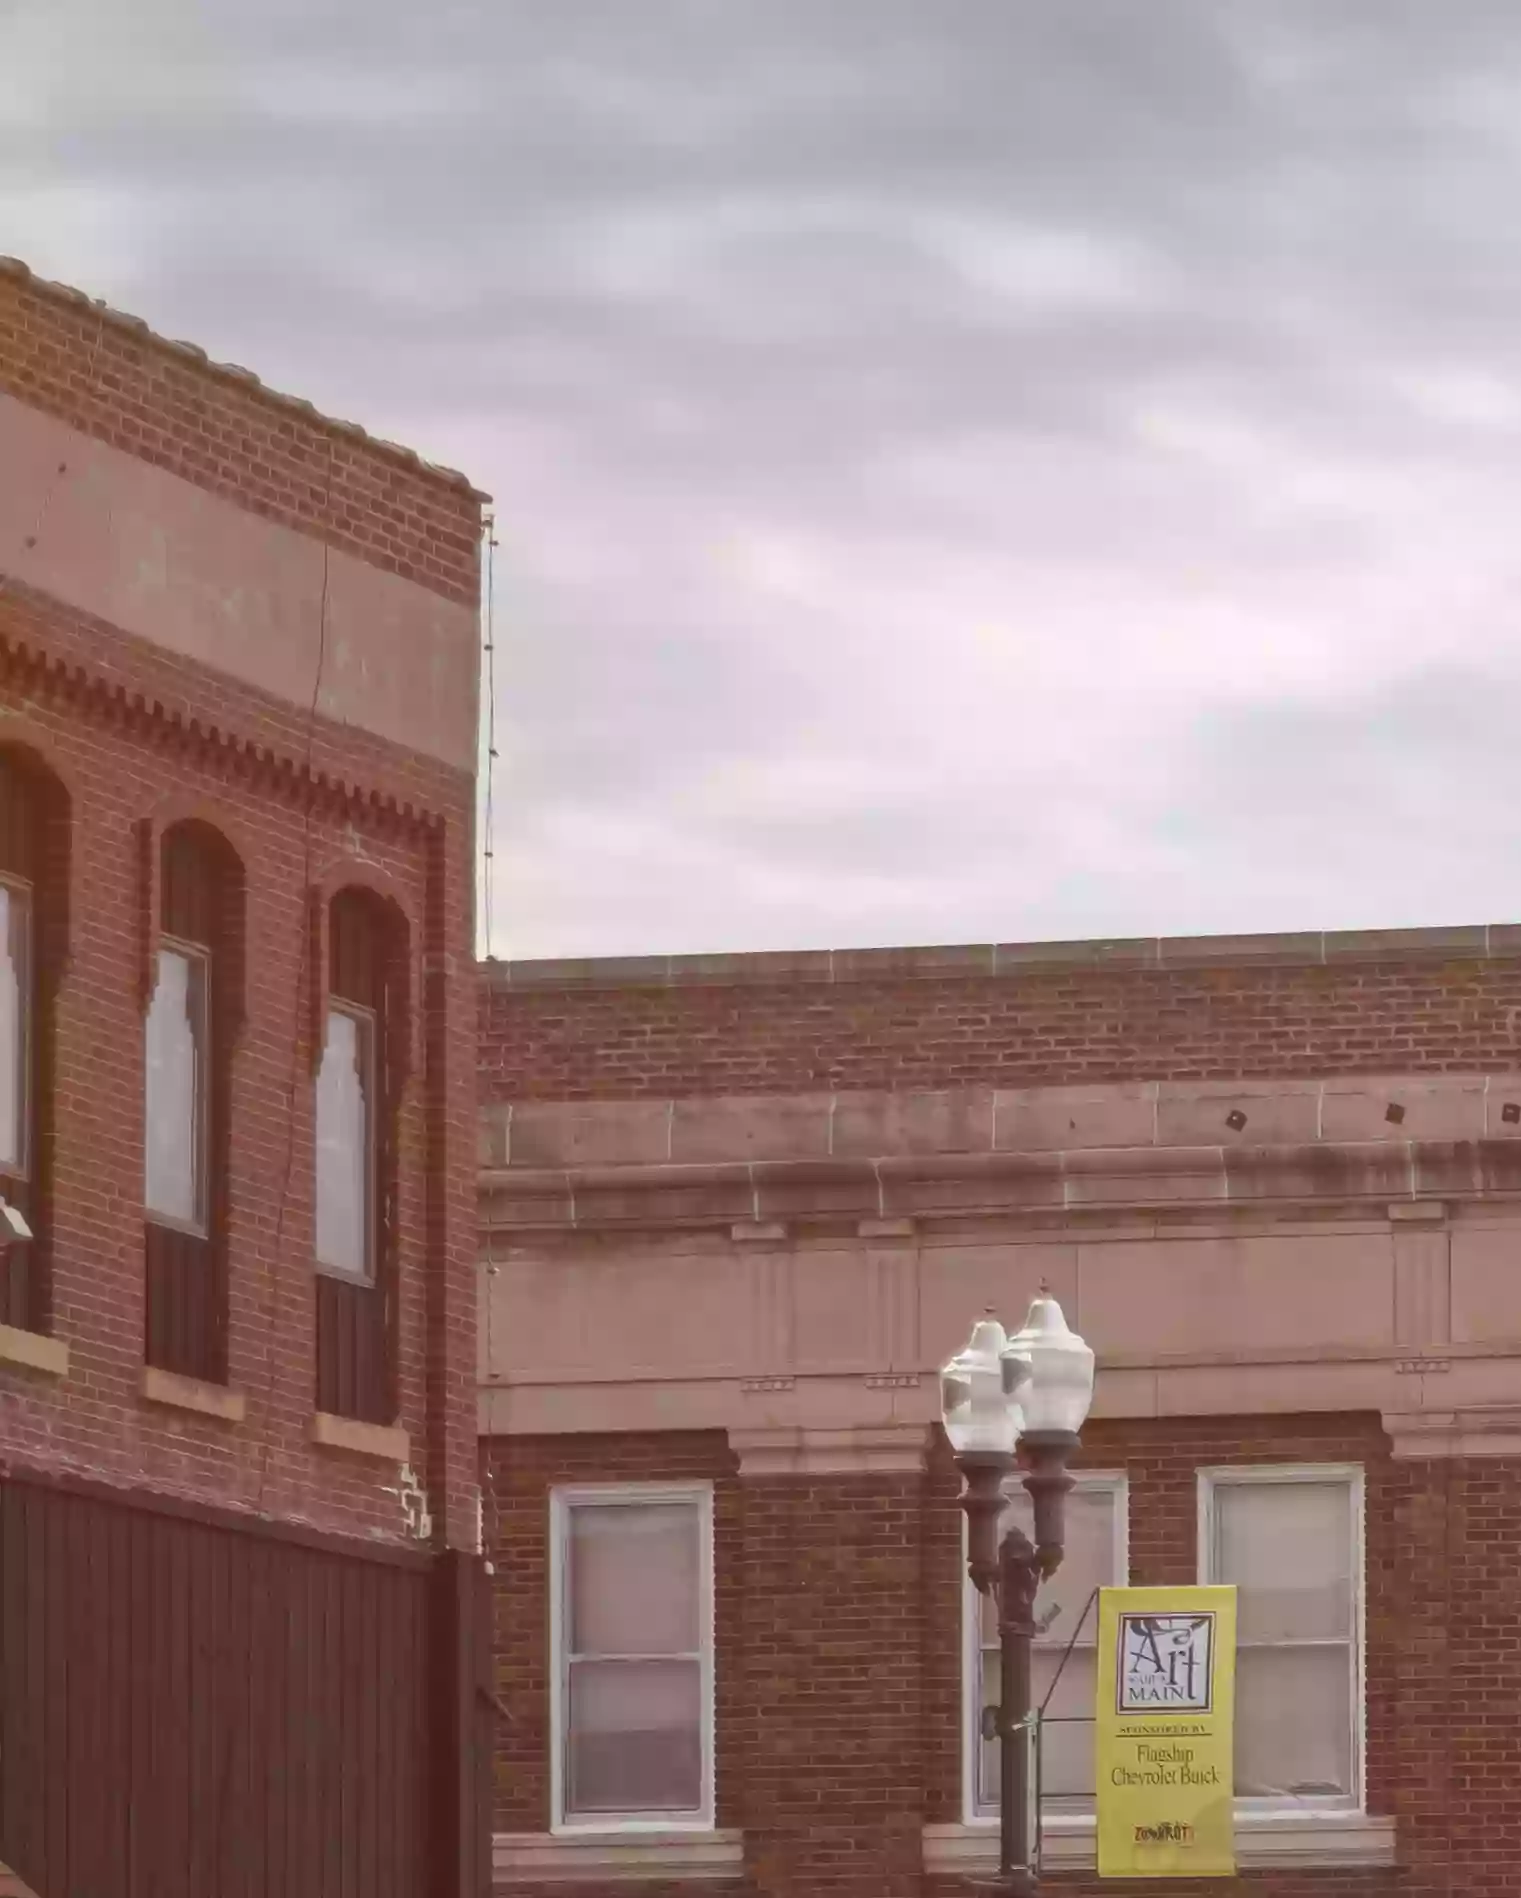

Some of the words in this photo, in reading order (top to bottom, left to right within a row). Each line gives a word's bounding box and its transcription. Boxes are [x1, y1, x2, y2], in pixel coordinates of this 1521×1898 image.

[1130, 1622, 1201, 1699] Art
[1129, 1687, 1185, 1701] MAIN
[1119, 1725, 1188, 1734] SPONSORED
[1136, 1742, 1194, 1767] Flagship
[1111, 1764, 1177, 1786] Chevrolet
[1179, 1765, 1221, 1785] Buick
